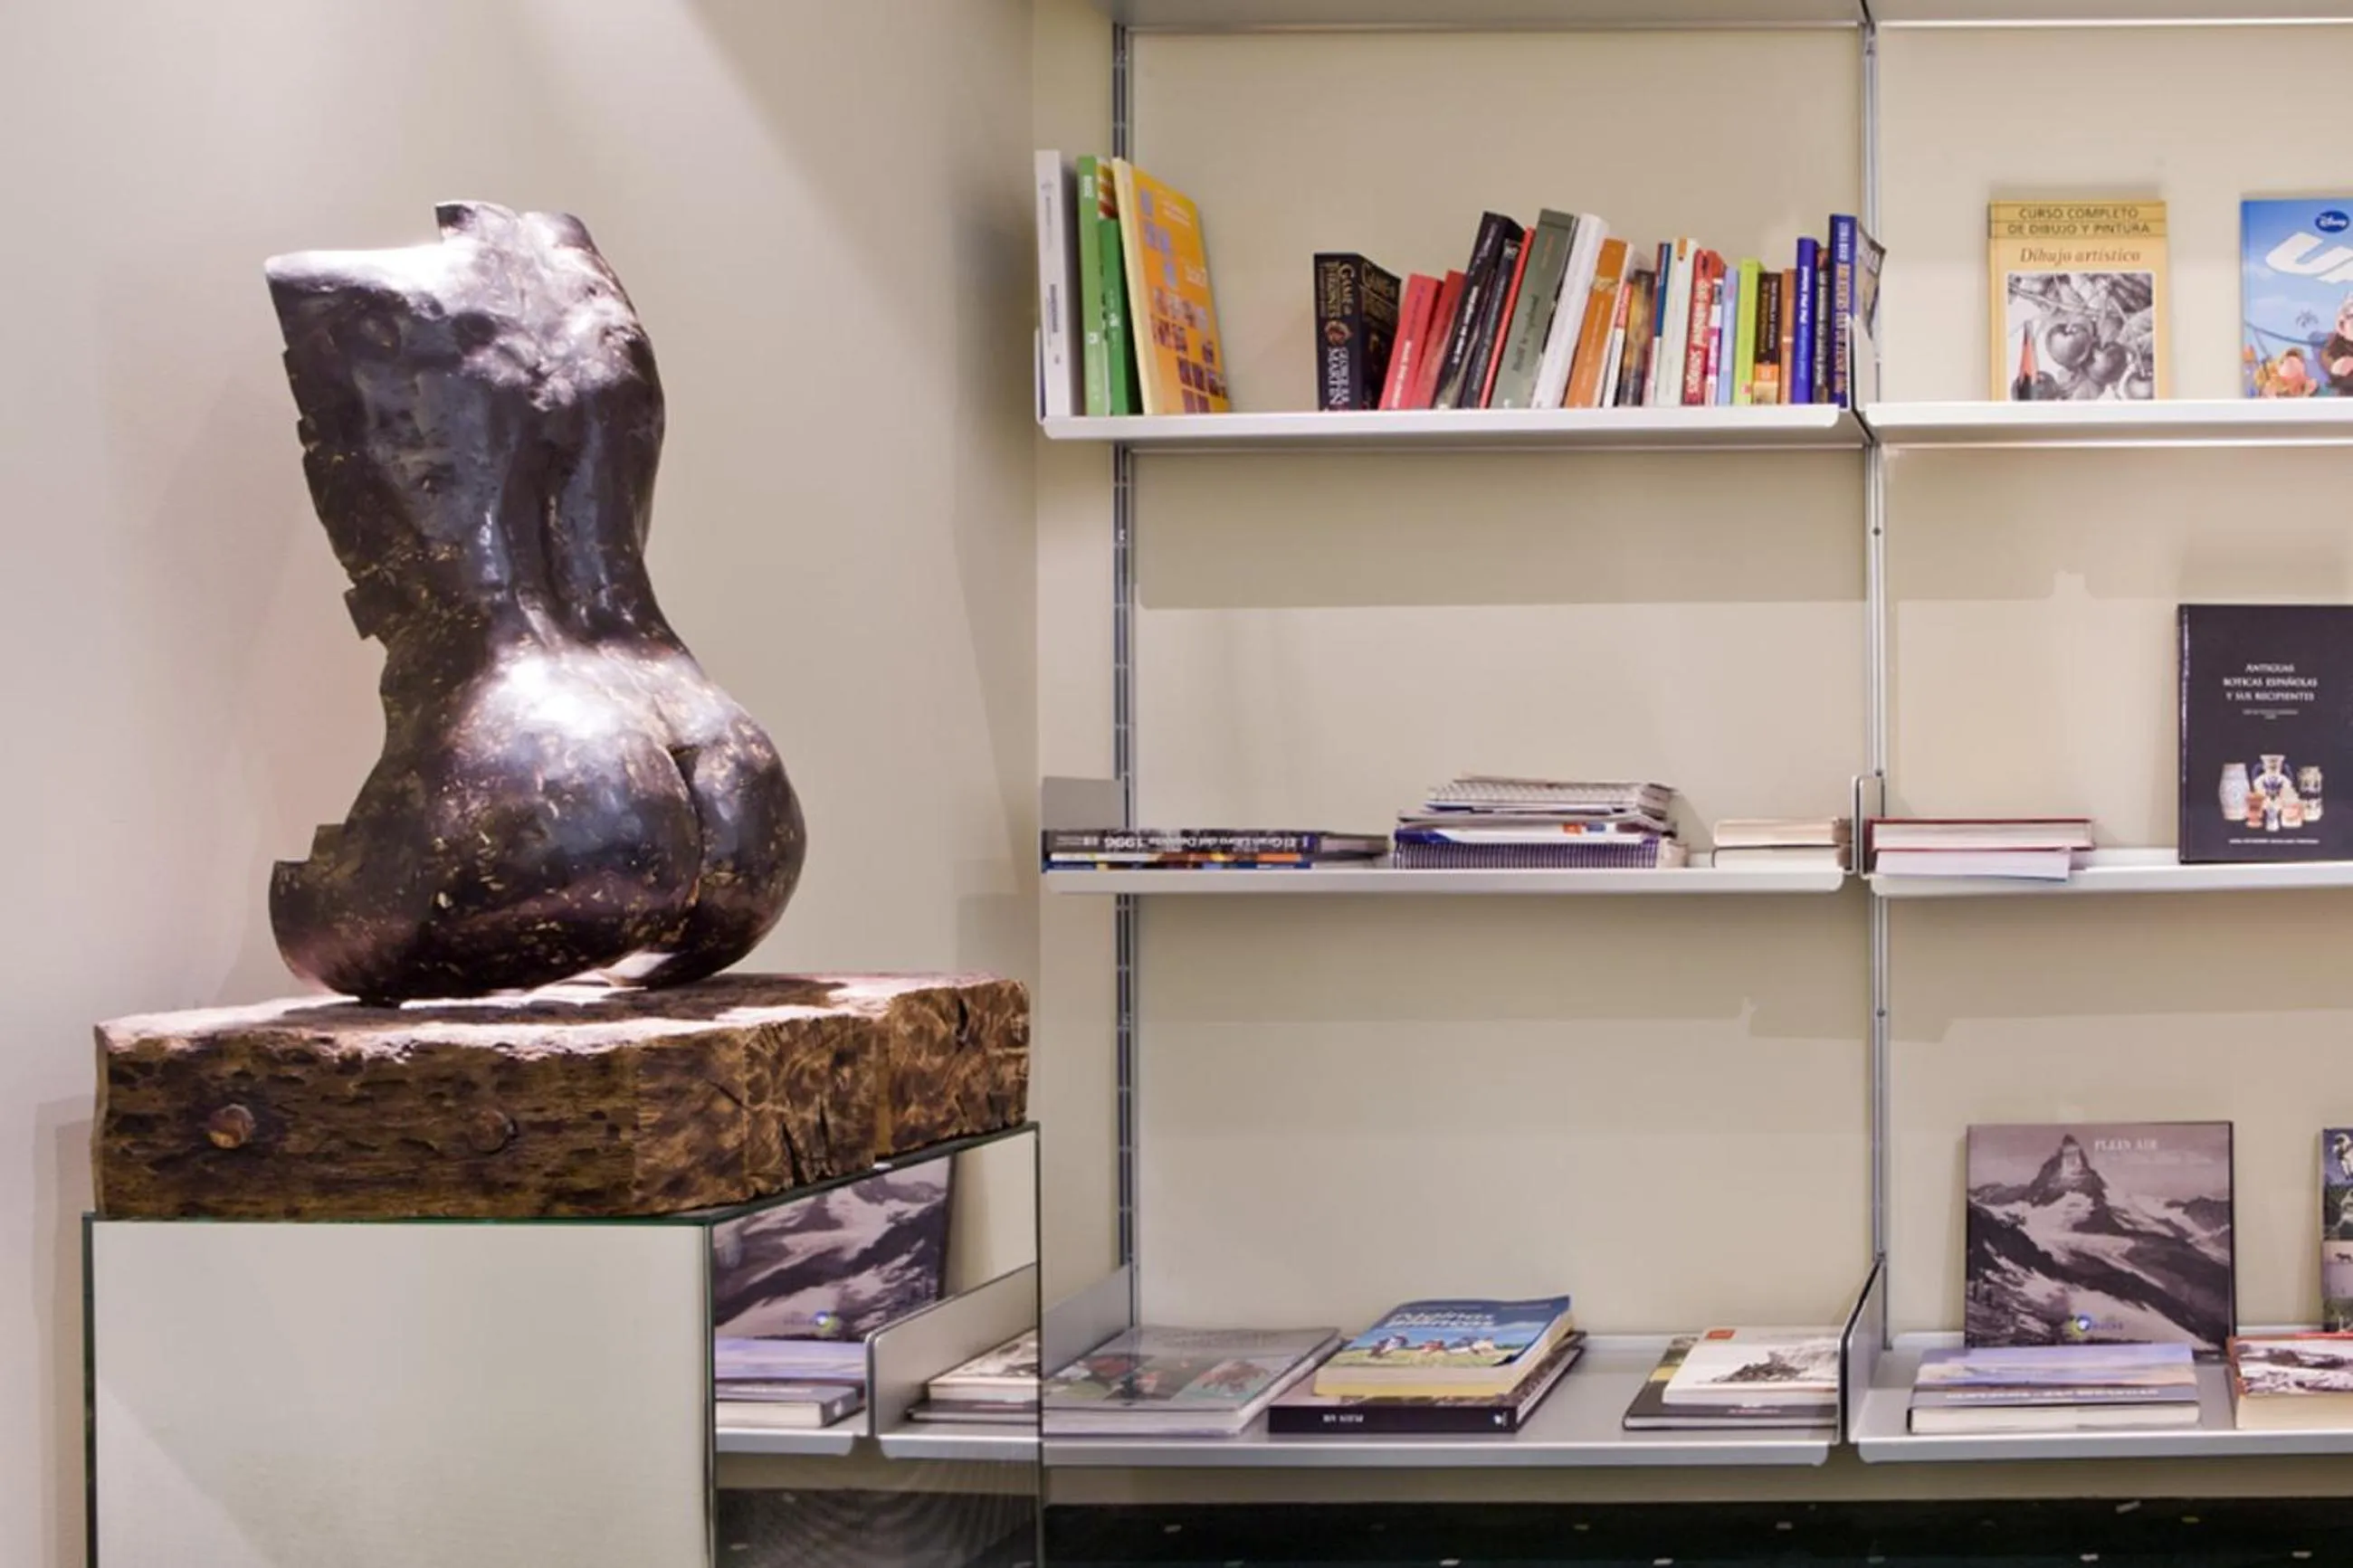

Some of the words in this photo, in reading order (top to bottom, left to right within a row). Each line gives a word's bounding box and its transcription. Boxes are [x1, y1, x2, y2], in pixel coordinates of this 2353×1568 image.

[2018, 207, 2063, 220] CURSO
[2066, 207, 2139, 220] COMPLETO
[2319, 214, 2348, 227] Disney
[2007, 223, 2024, 235] DE
[2028, 223, 2078, 235] DIBUJO
[2082, 223, 2090, 234] Y
[2092, 223, 2151, 234] PINTURA
[2019, 247, 2072, 266] Dibujo
[2244, 663, 2295, 672] ANTIGUAS
[2224, 677, 2263, 687] BOTICAS
